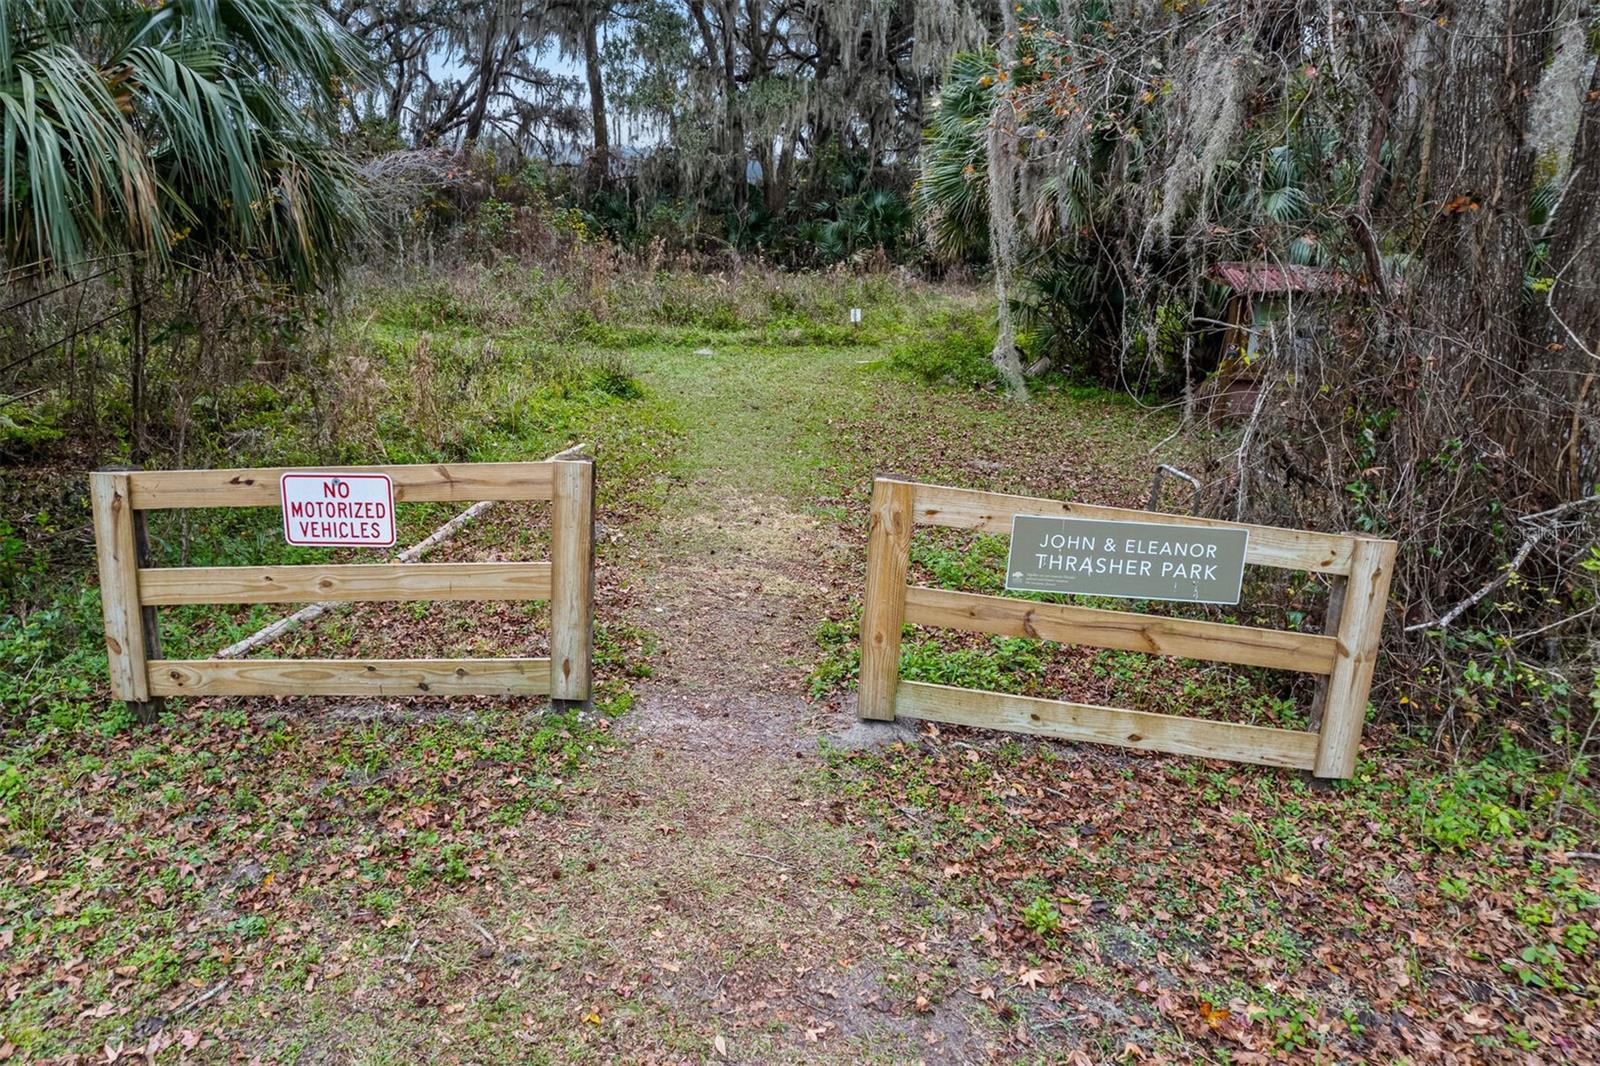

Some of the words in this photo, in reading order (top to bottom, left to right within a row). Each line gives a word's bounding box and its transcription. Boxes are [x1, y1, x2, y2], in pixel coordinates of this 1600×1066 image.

[323, 481, 350, 499] NO
[291, 501, 386, 519] MOTORIZED
[299, 521, 381, 539] VEHICLES
[1039, 534, 1096, 551] JOHN
[1103, 538, 1117, 553] &
[1125, 539, 1217, 559] ELEANOR
[1035, 553, 1152, 577] THRASHER
[1160, 562, 1218, 581] PARK
